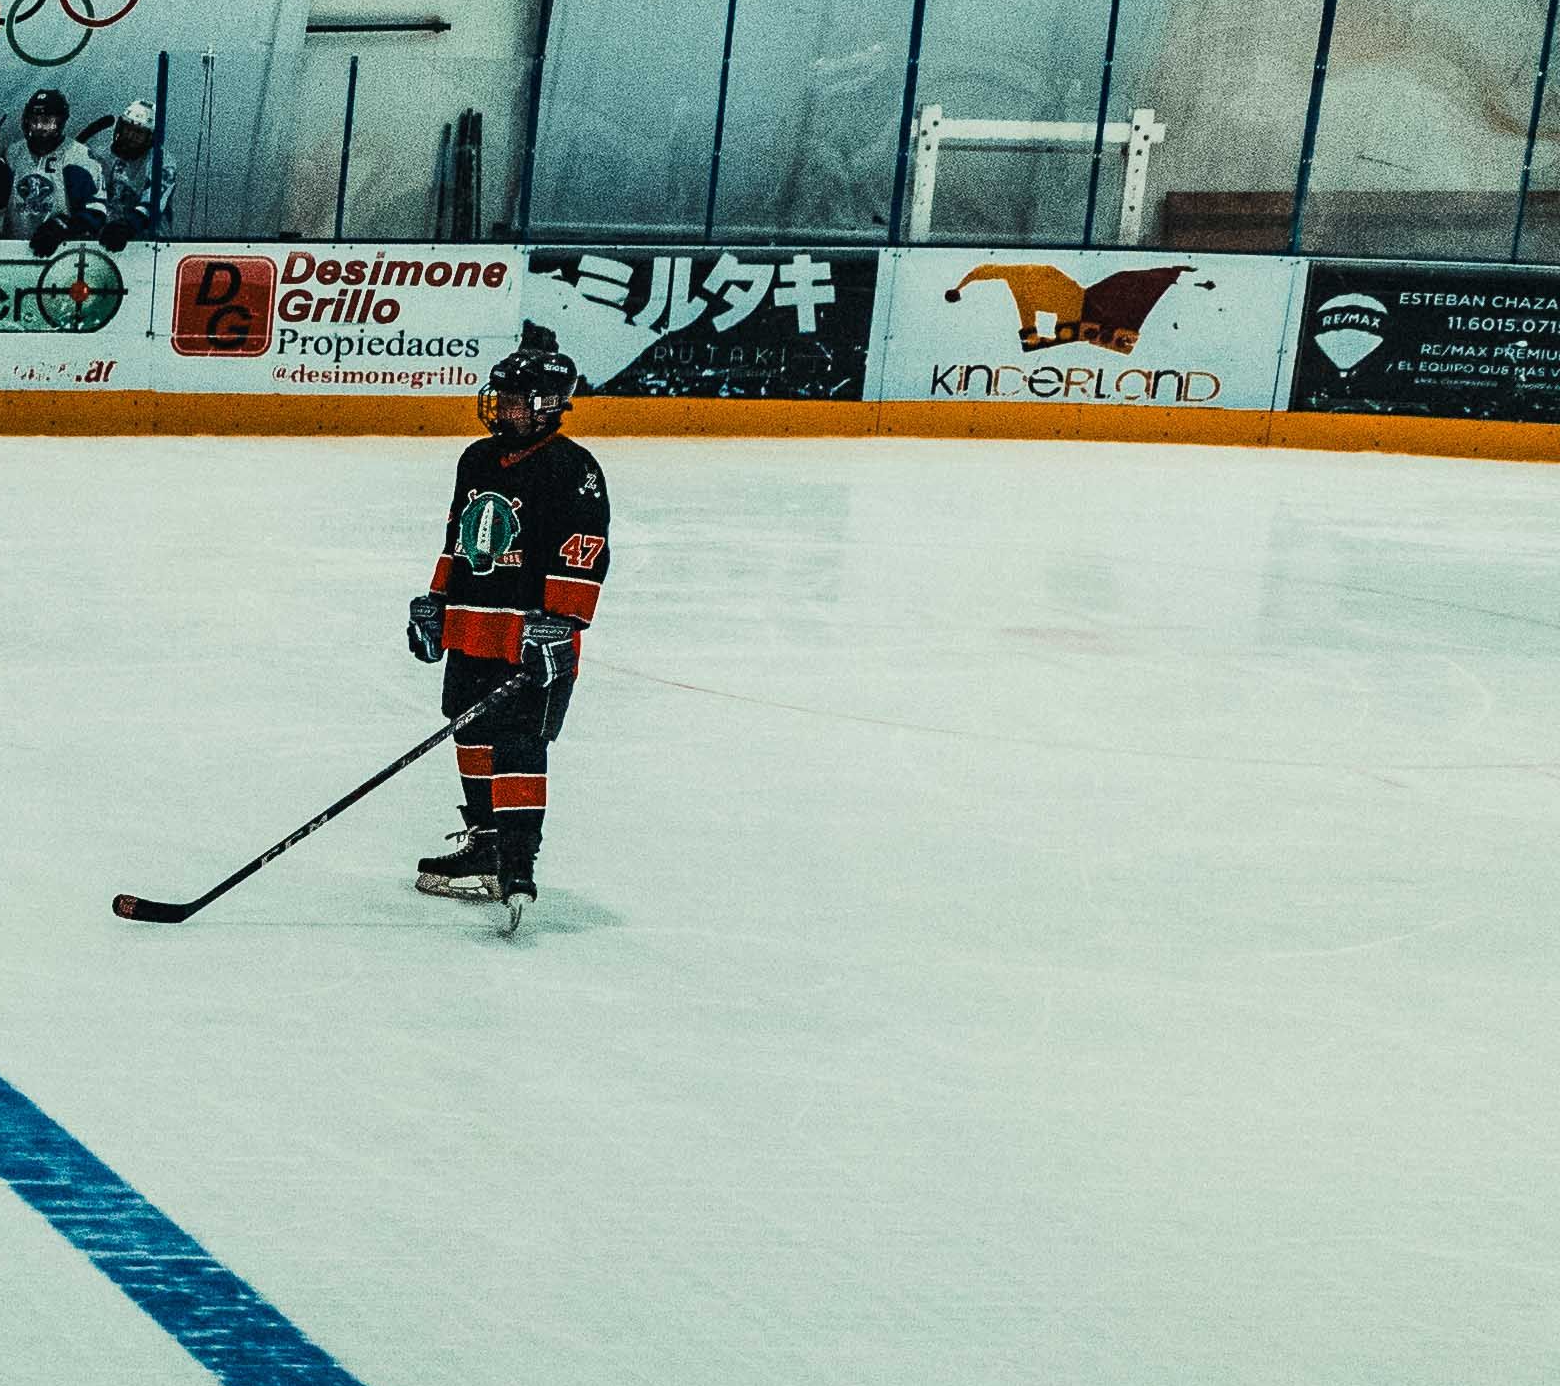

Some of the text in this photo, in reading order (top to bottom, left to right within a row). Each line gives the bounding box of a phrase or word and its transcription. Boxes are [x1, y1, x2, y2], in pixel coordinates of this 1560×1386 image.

[280, 251, 508, 288] Desimone
[278, 289, 401, 324] Grillo
[1399, 292, 1486, 308] ESTEBAN
[1322, 312, 1381, 329] RE/MAX
[1447, 316, 1560, 334] 11.6015.071
[1420, 343, 1560, 361] RE/MAX PREMIU
[272, 364, 478, 389] @desimonegrillo
[1420, 362, 1473, 373] EQUIPO
[560, 533, 605, 569] 47
